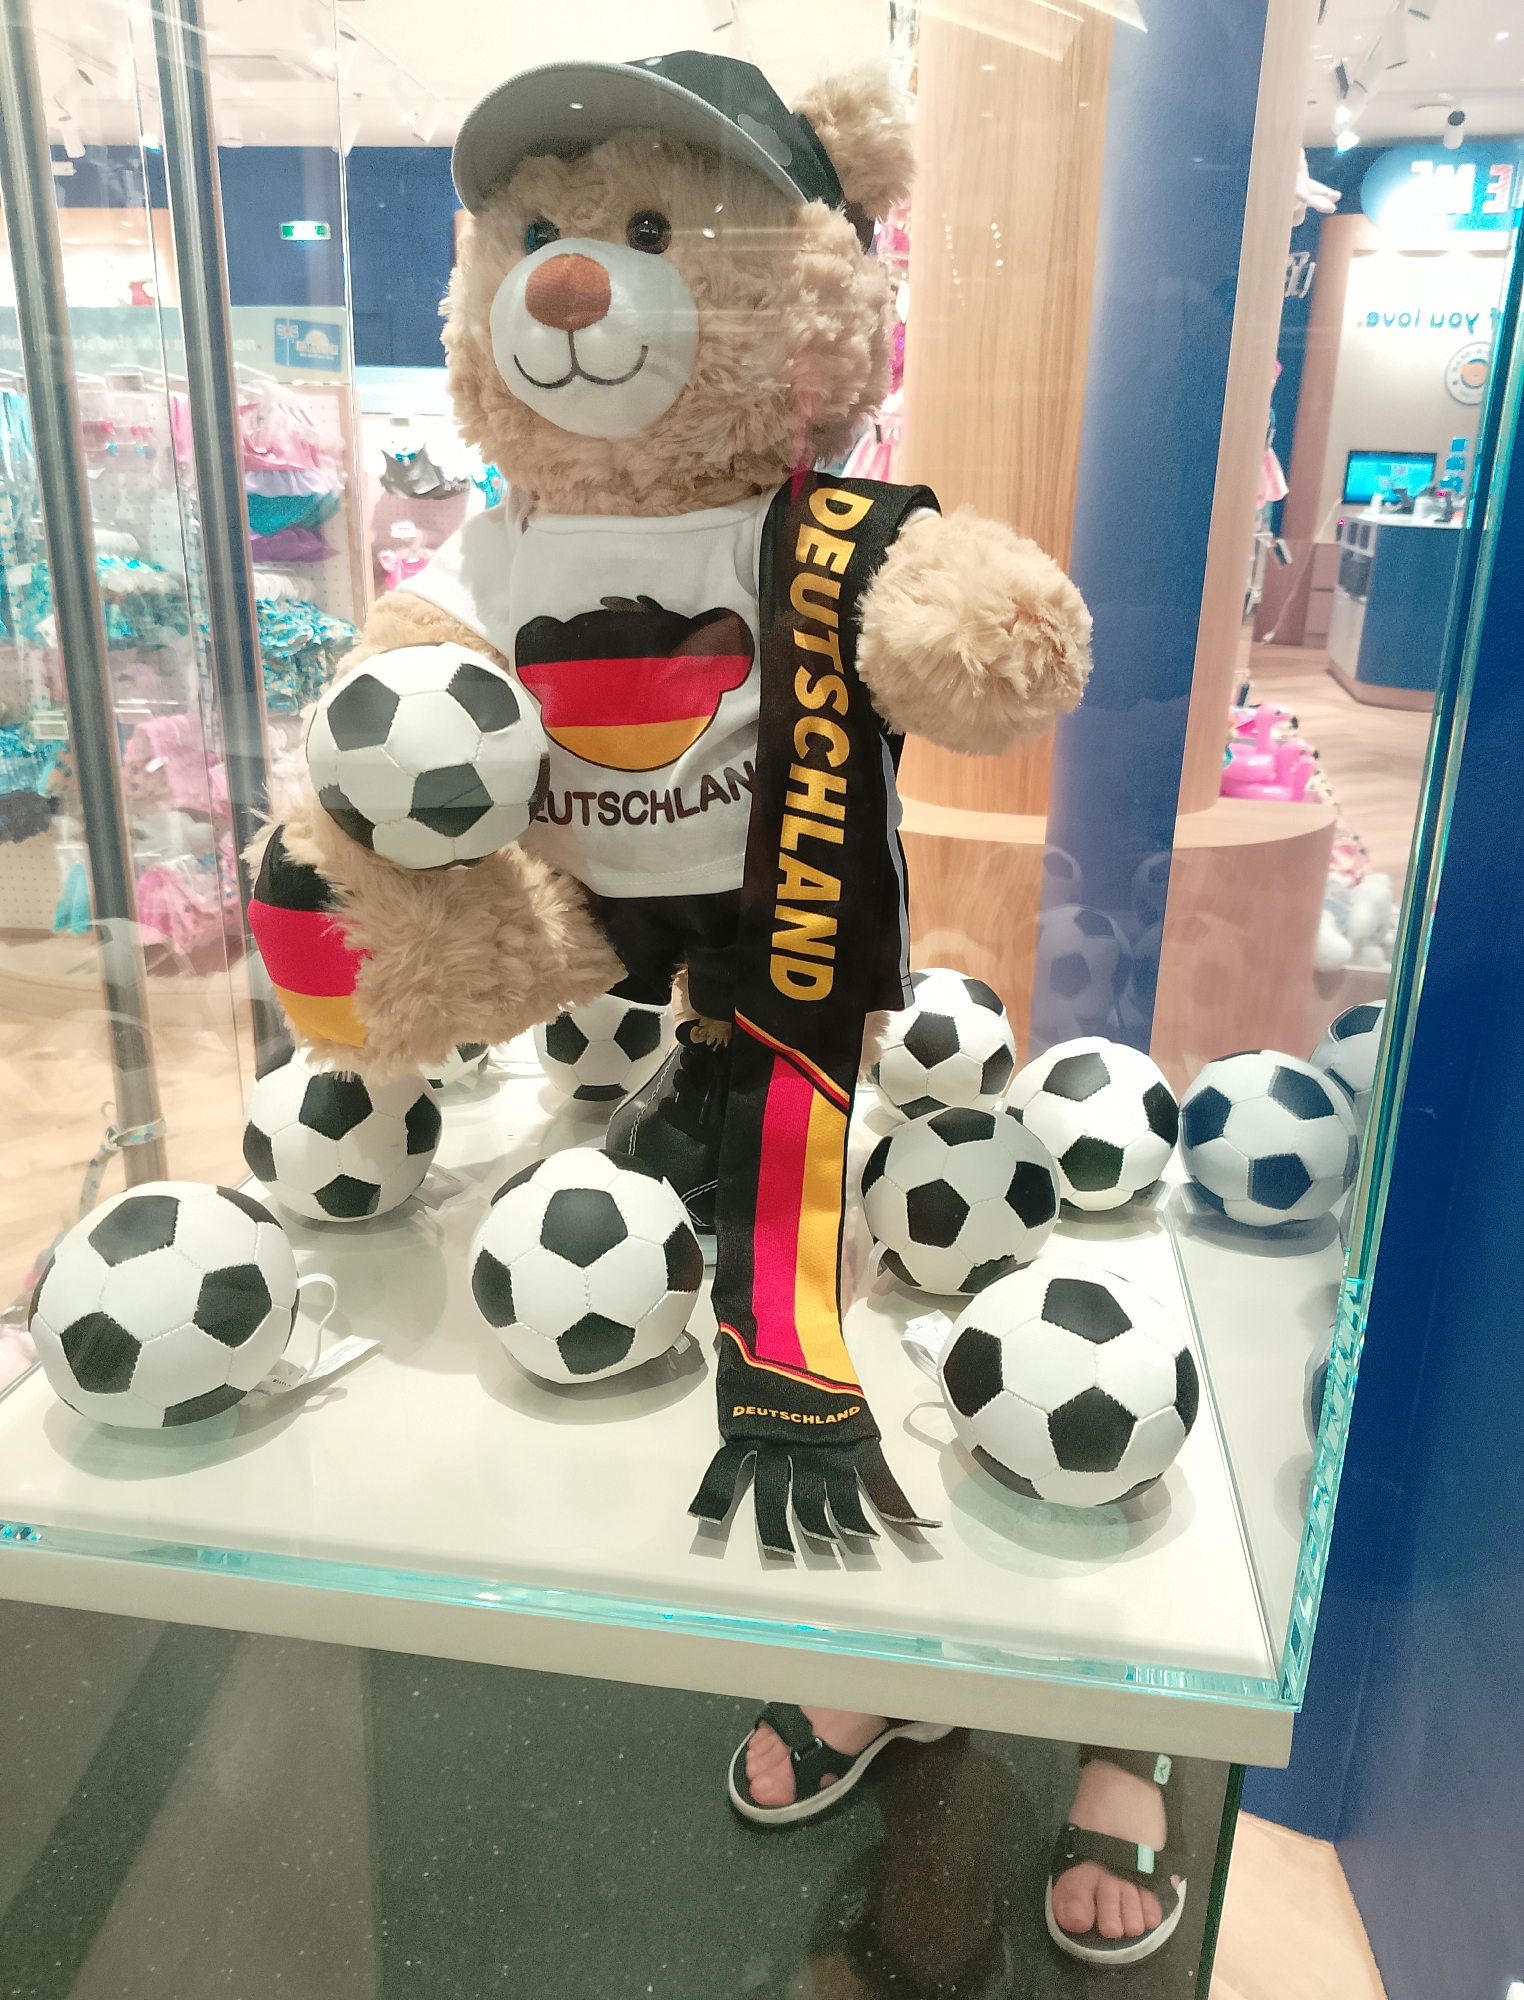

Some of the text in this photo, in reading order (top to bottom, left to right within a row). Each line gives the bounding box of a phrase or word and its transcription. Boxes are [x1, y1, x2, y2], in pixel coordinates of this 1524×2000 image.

[769, 486, 874, 1002] DEUTSCHLAND
[534, 760, 756, 827] UTSCHLAN
[732, 1405, 861, 1425] DEUTSCHLAND
